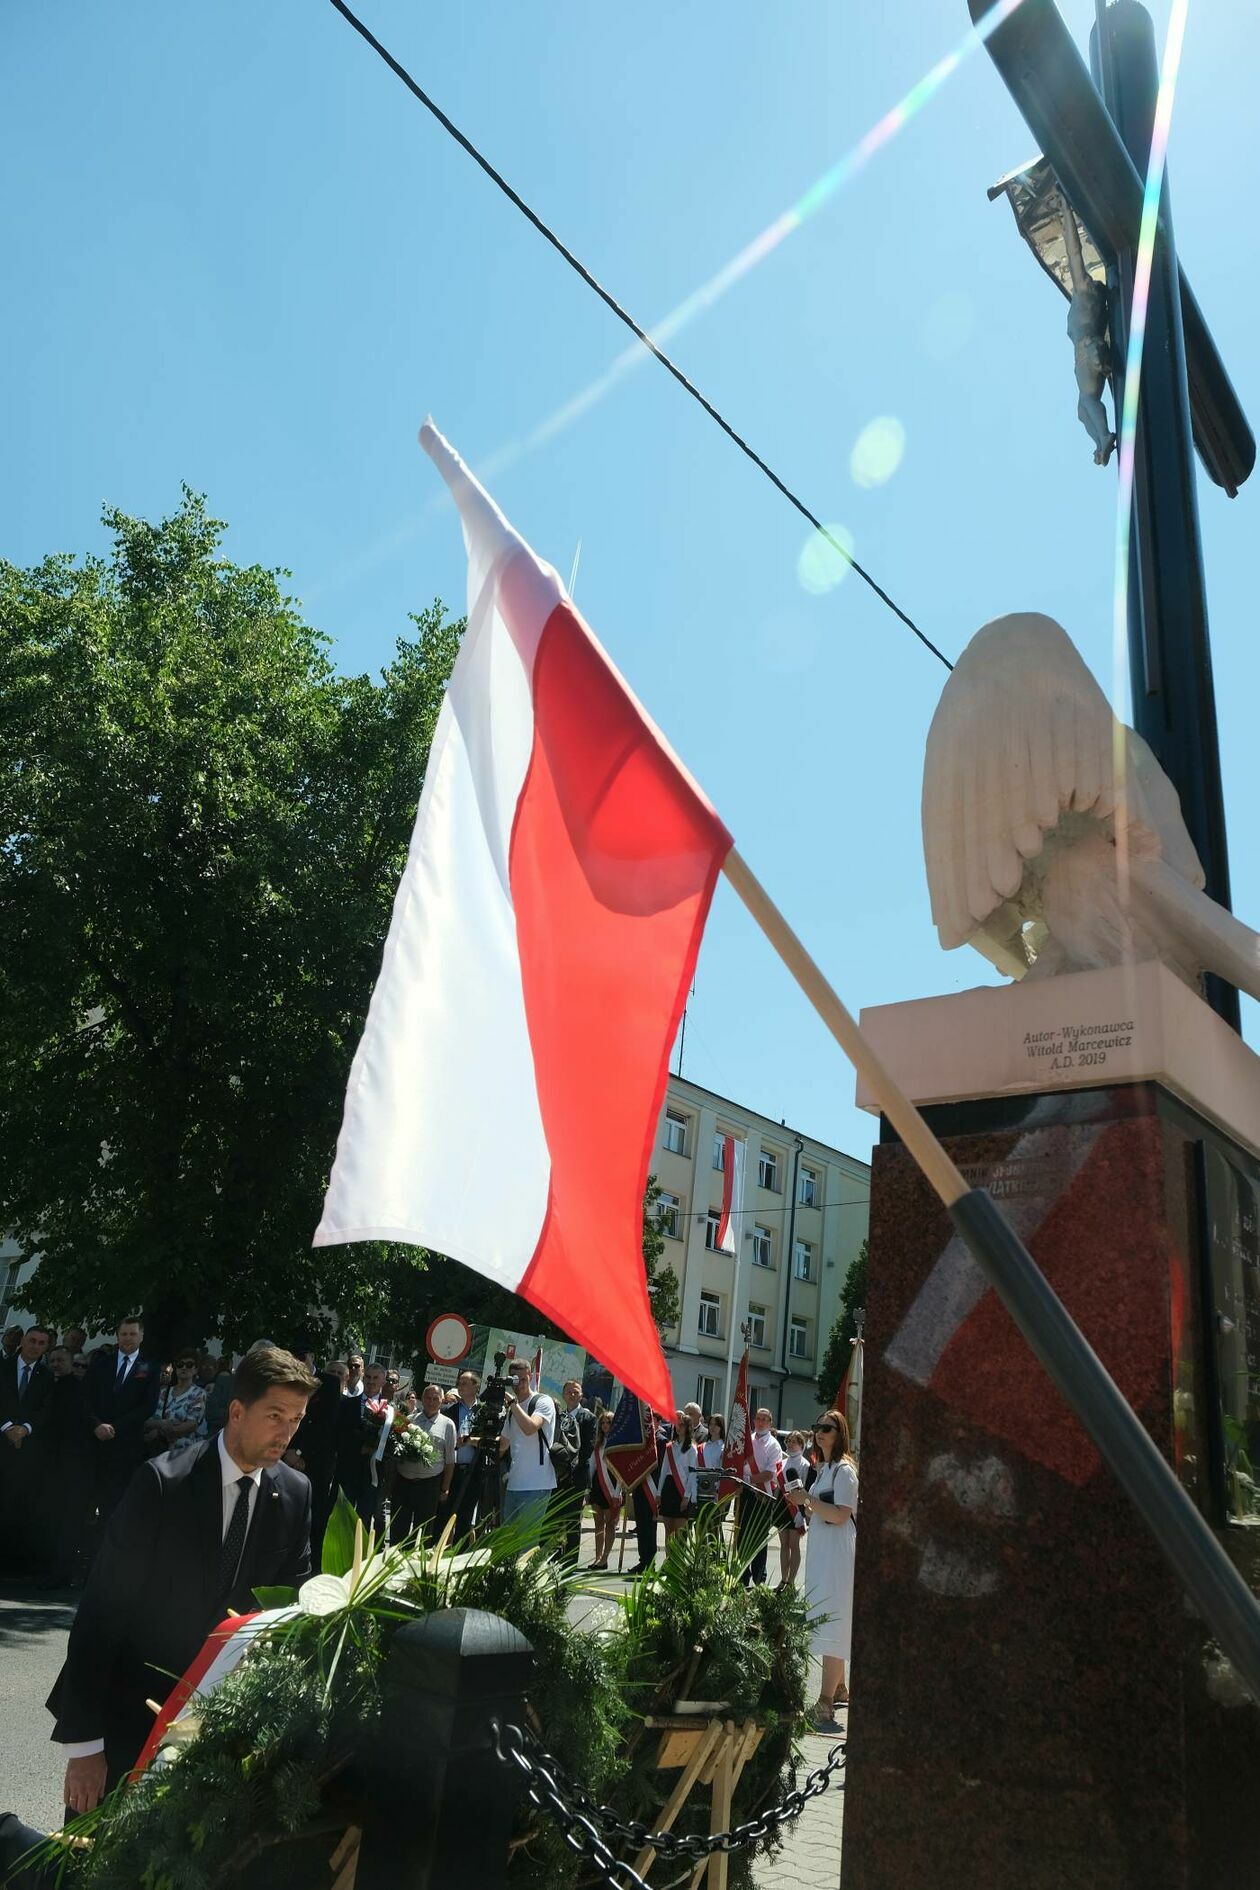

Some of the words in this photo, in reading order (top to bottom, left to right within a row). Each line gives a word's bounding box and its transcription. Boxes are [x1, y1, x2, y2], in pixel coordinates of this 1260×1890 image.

[1023, 1020, 1135, 1044] Autor-Wykonawca
[1026, 1042, 1063, 1058] Witold
[1068, 1035, 1133, 1053] Marcewicz
[1050, 1056, 1074, 1070] A.D.
[1078, 1051, 1106, 1067] 2019
